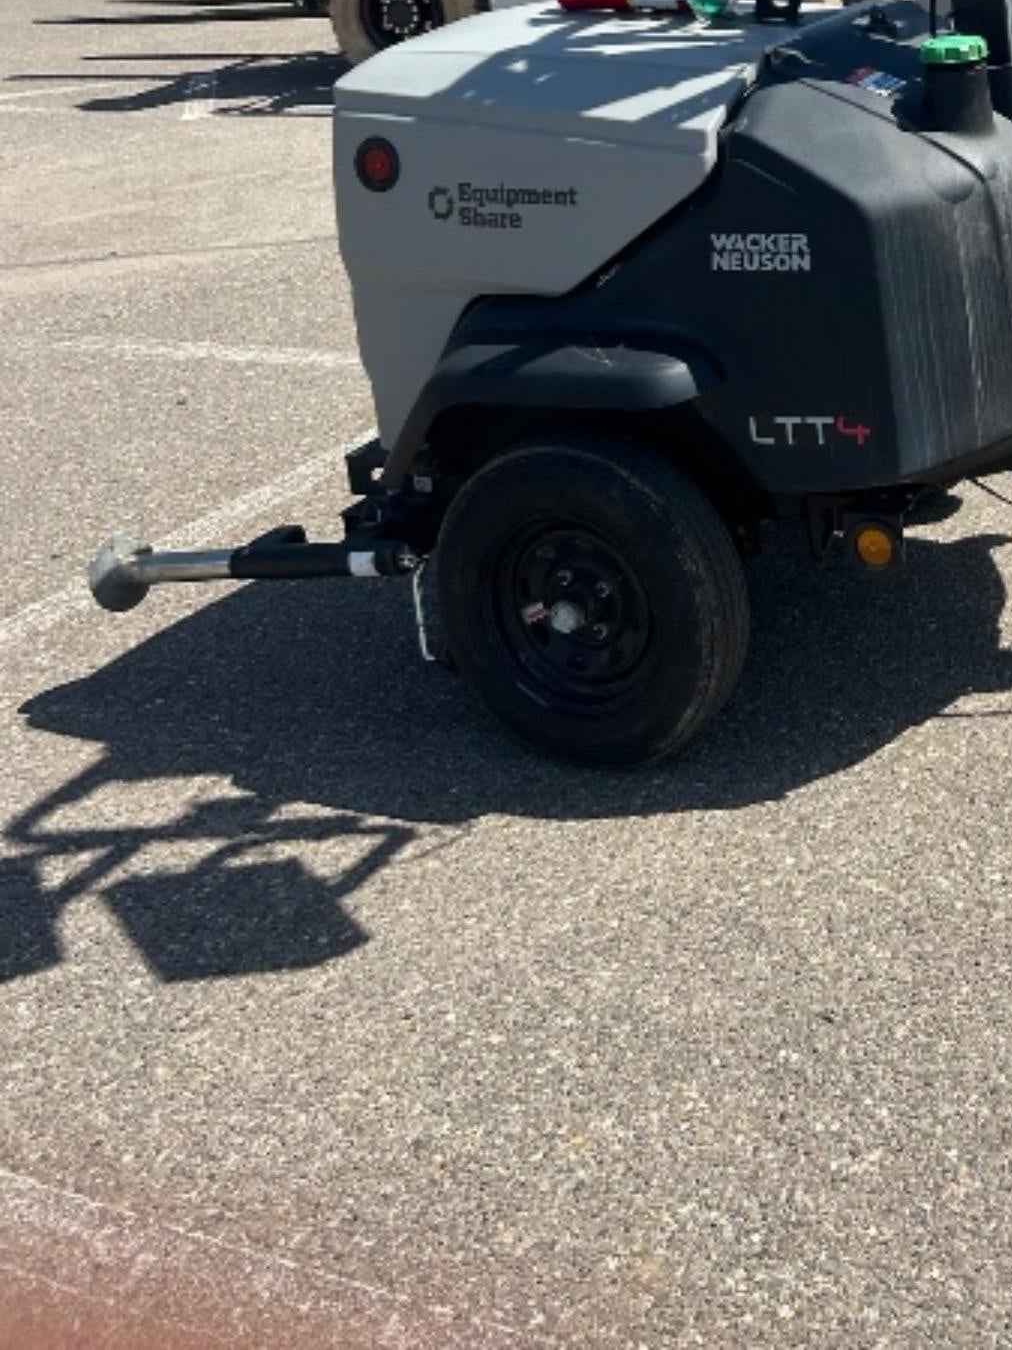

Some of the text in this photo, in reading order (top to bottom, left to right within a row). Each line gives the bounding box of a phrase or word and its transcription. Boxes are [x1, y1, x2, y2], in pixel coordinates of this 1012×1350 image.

[457, 182, 577, 208] Equipment
[458, 206, 522, 229] Share
[710, 233, 810, 252] WACKER
[711, 251, 811, 271] NEUSON
[748, 416, 871, 445] LTT4
